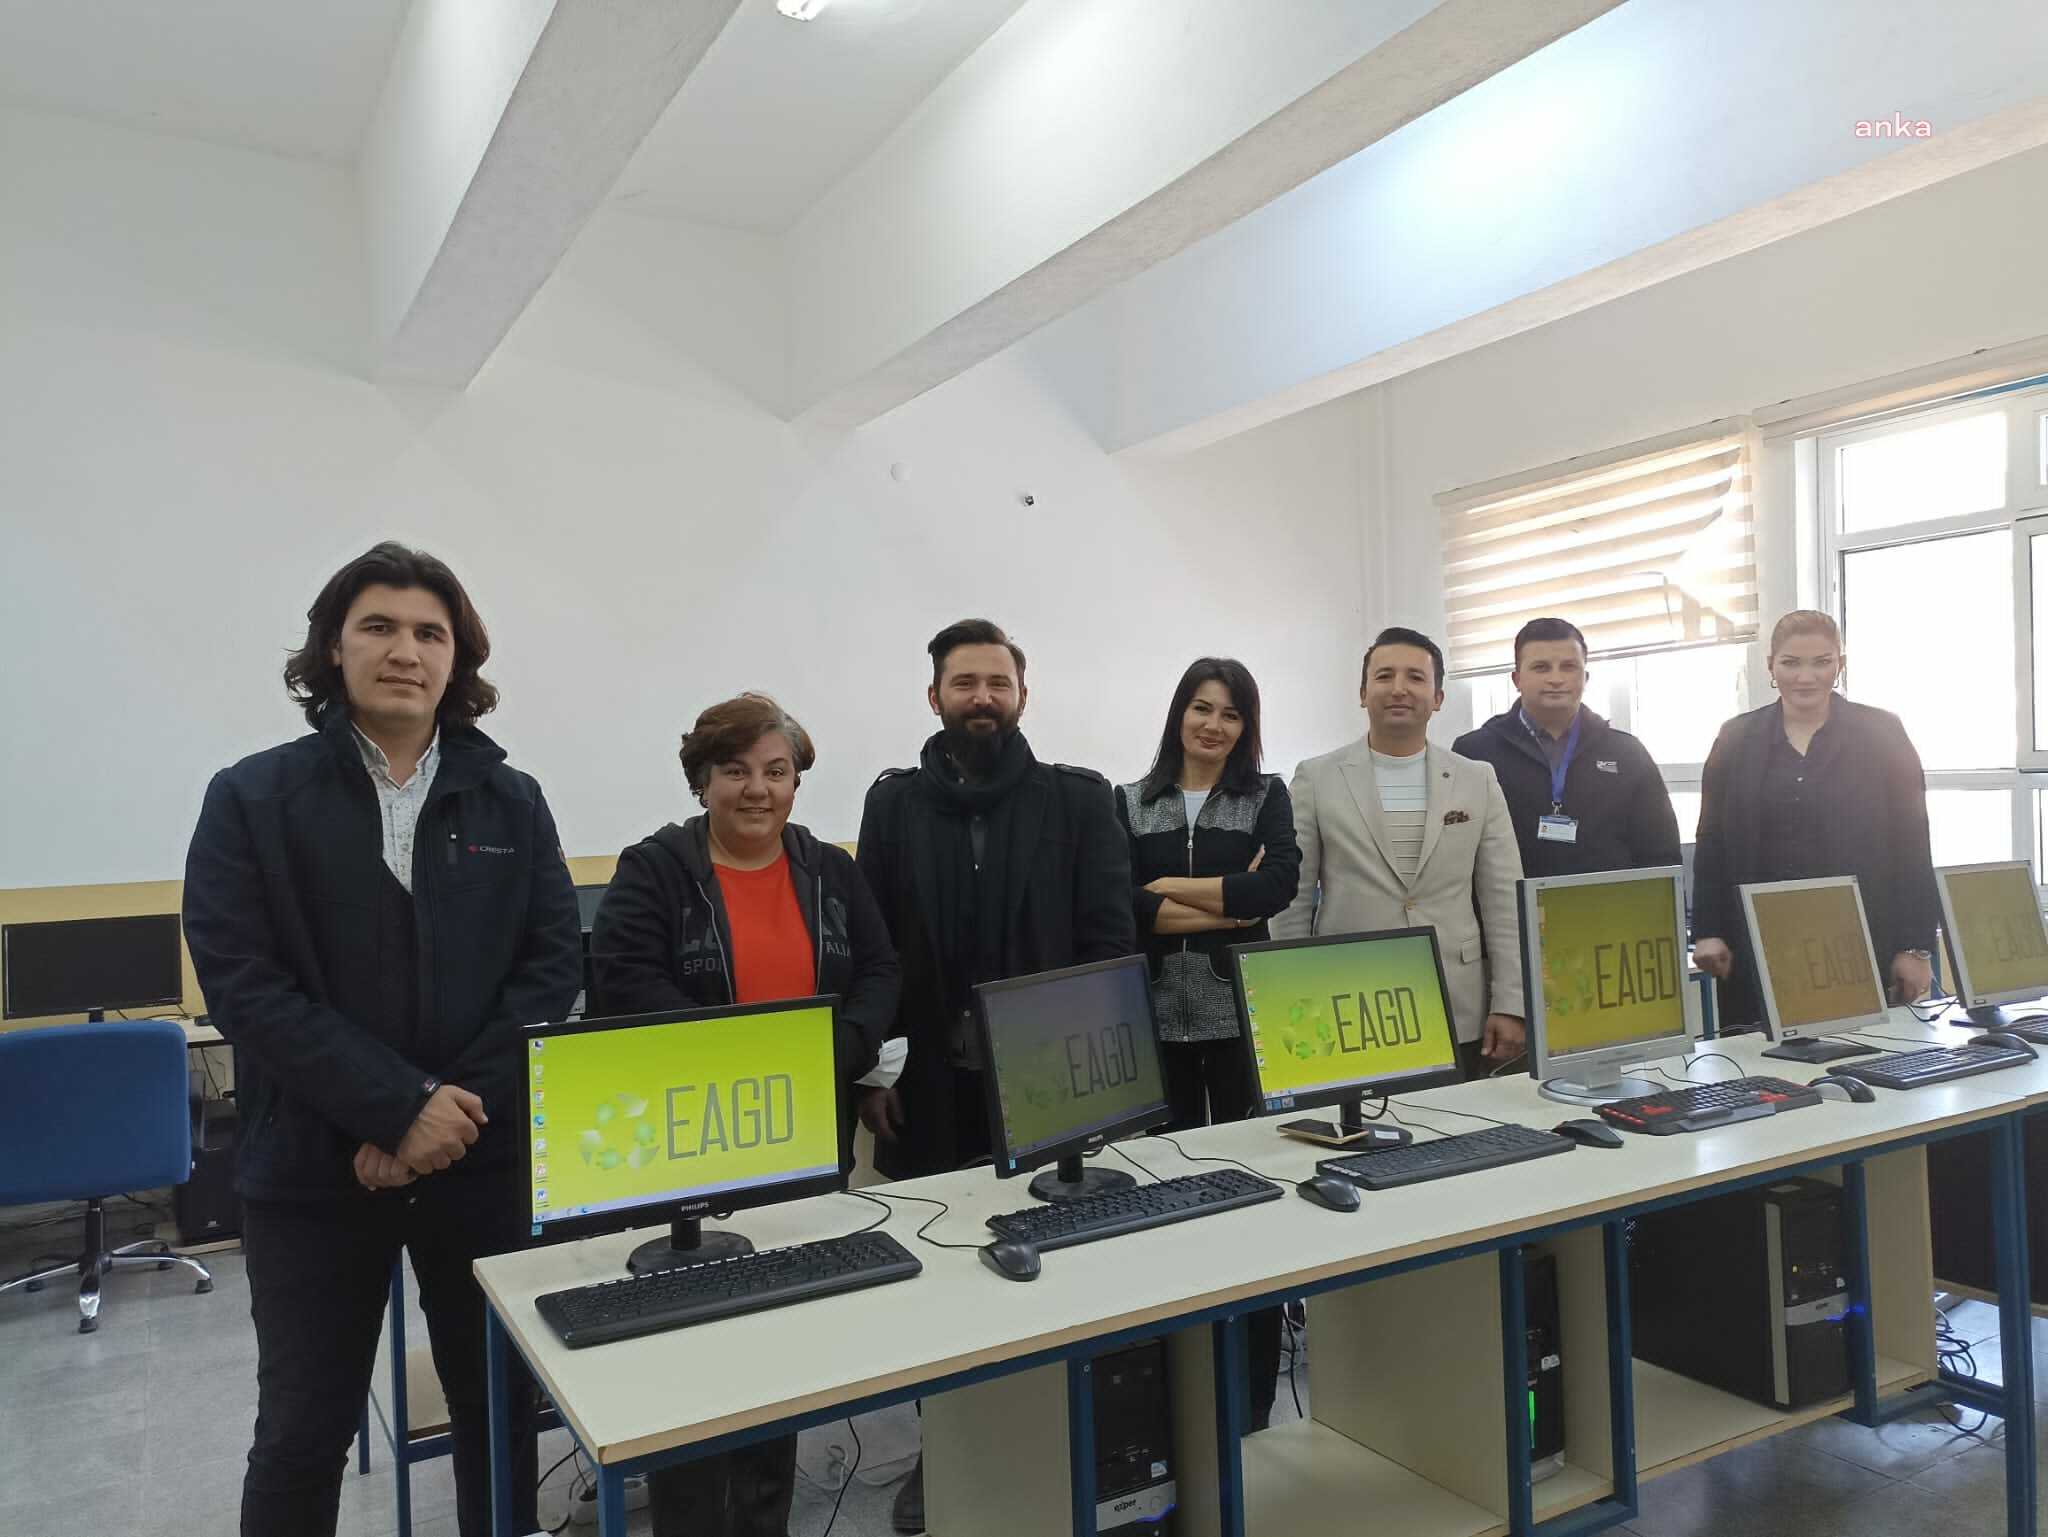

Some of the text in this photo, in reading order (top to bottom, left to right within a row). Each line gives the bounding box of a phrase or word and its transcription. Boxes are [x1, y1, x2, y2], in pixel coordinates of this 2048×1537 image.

[1595, 937, 1677, 1010] EAGD
[1332, 987, 1422, 1053] EAGD
[1064, 1022, 1139, 1098] EAGD
[665, 1073, 794, 1160] EAGD
[681, 1201, 709, 1212] PHILIPS
